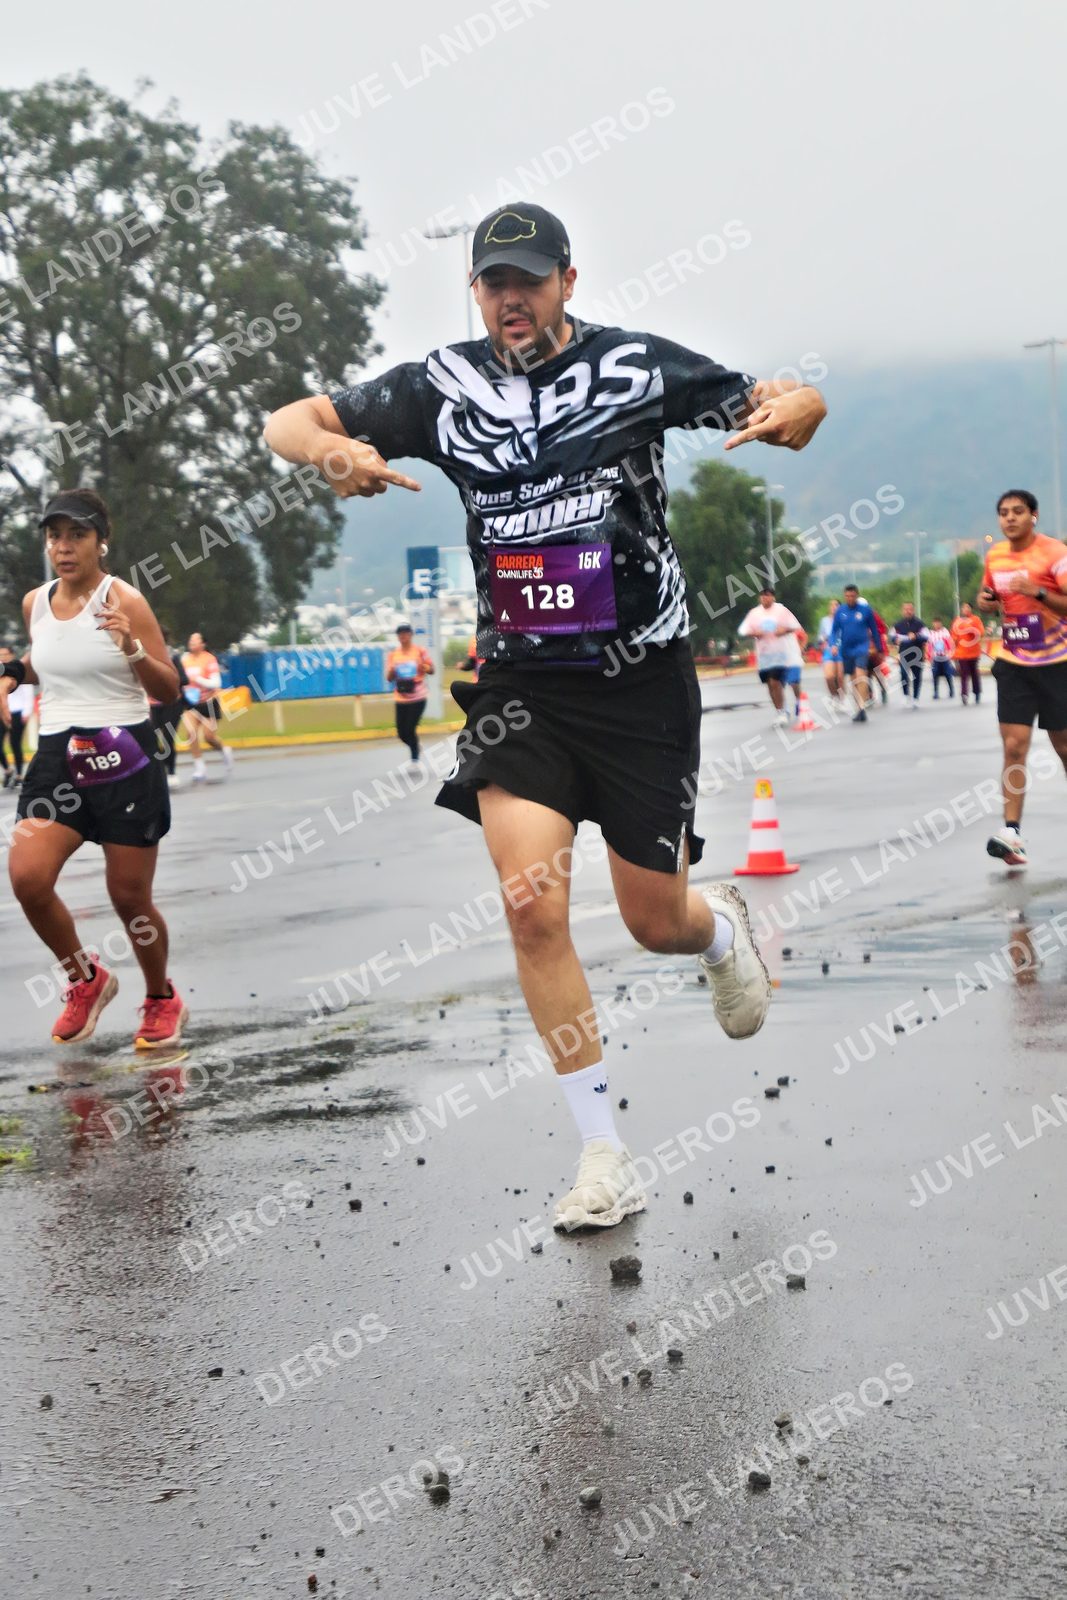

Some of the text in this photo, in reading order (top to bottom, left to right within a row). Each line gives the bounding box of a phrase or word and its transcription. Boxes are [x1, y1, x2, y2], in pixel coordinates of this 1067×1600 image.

[496, 555, 543, 569] CARRERA
[413, 568, 432, 593] E
[521, 584, 575, 610] 128
[85, 750, 121, 770] 189
